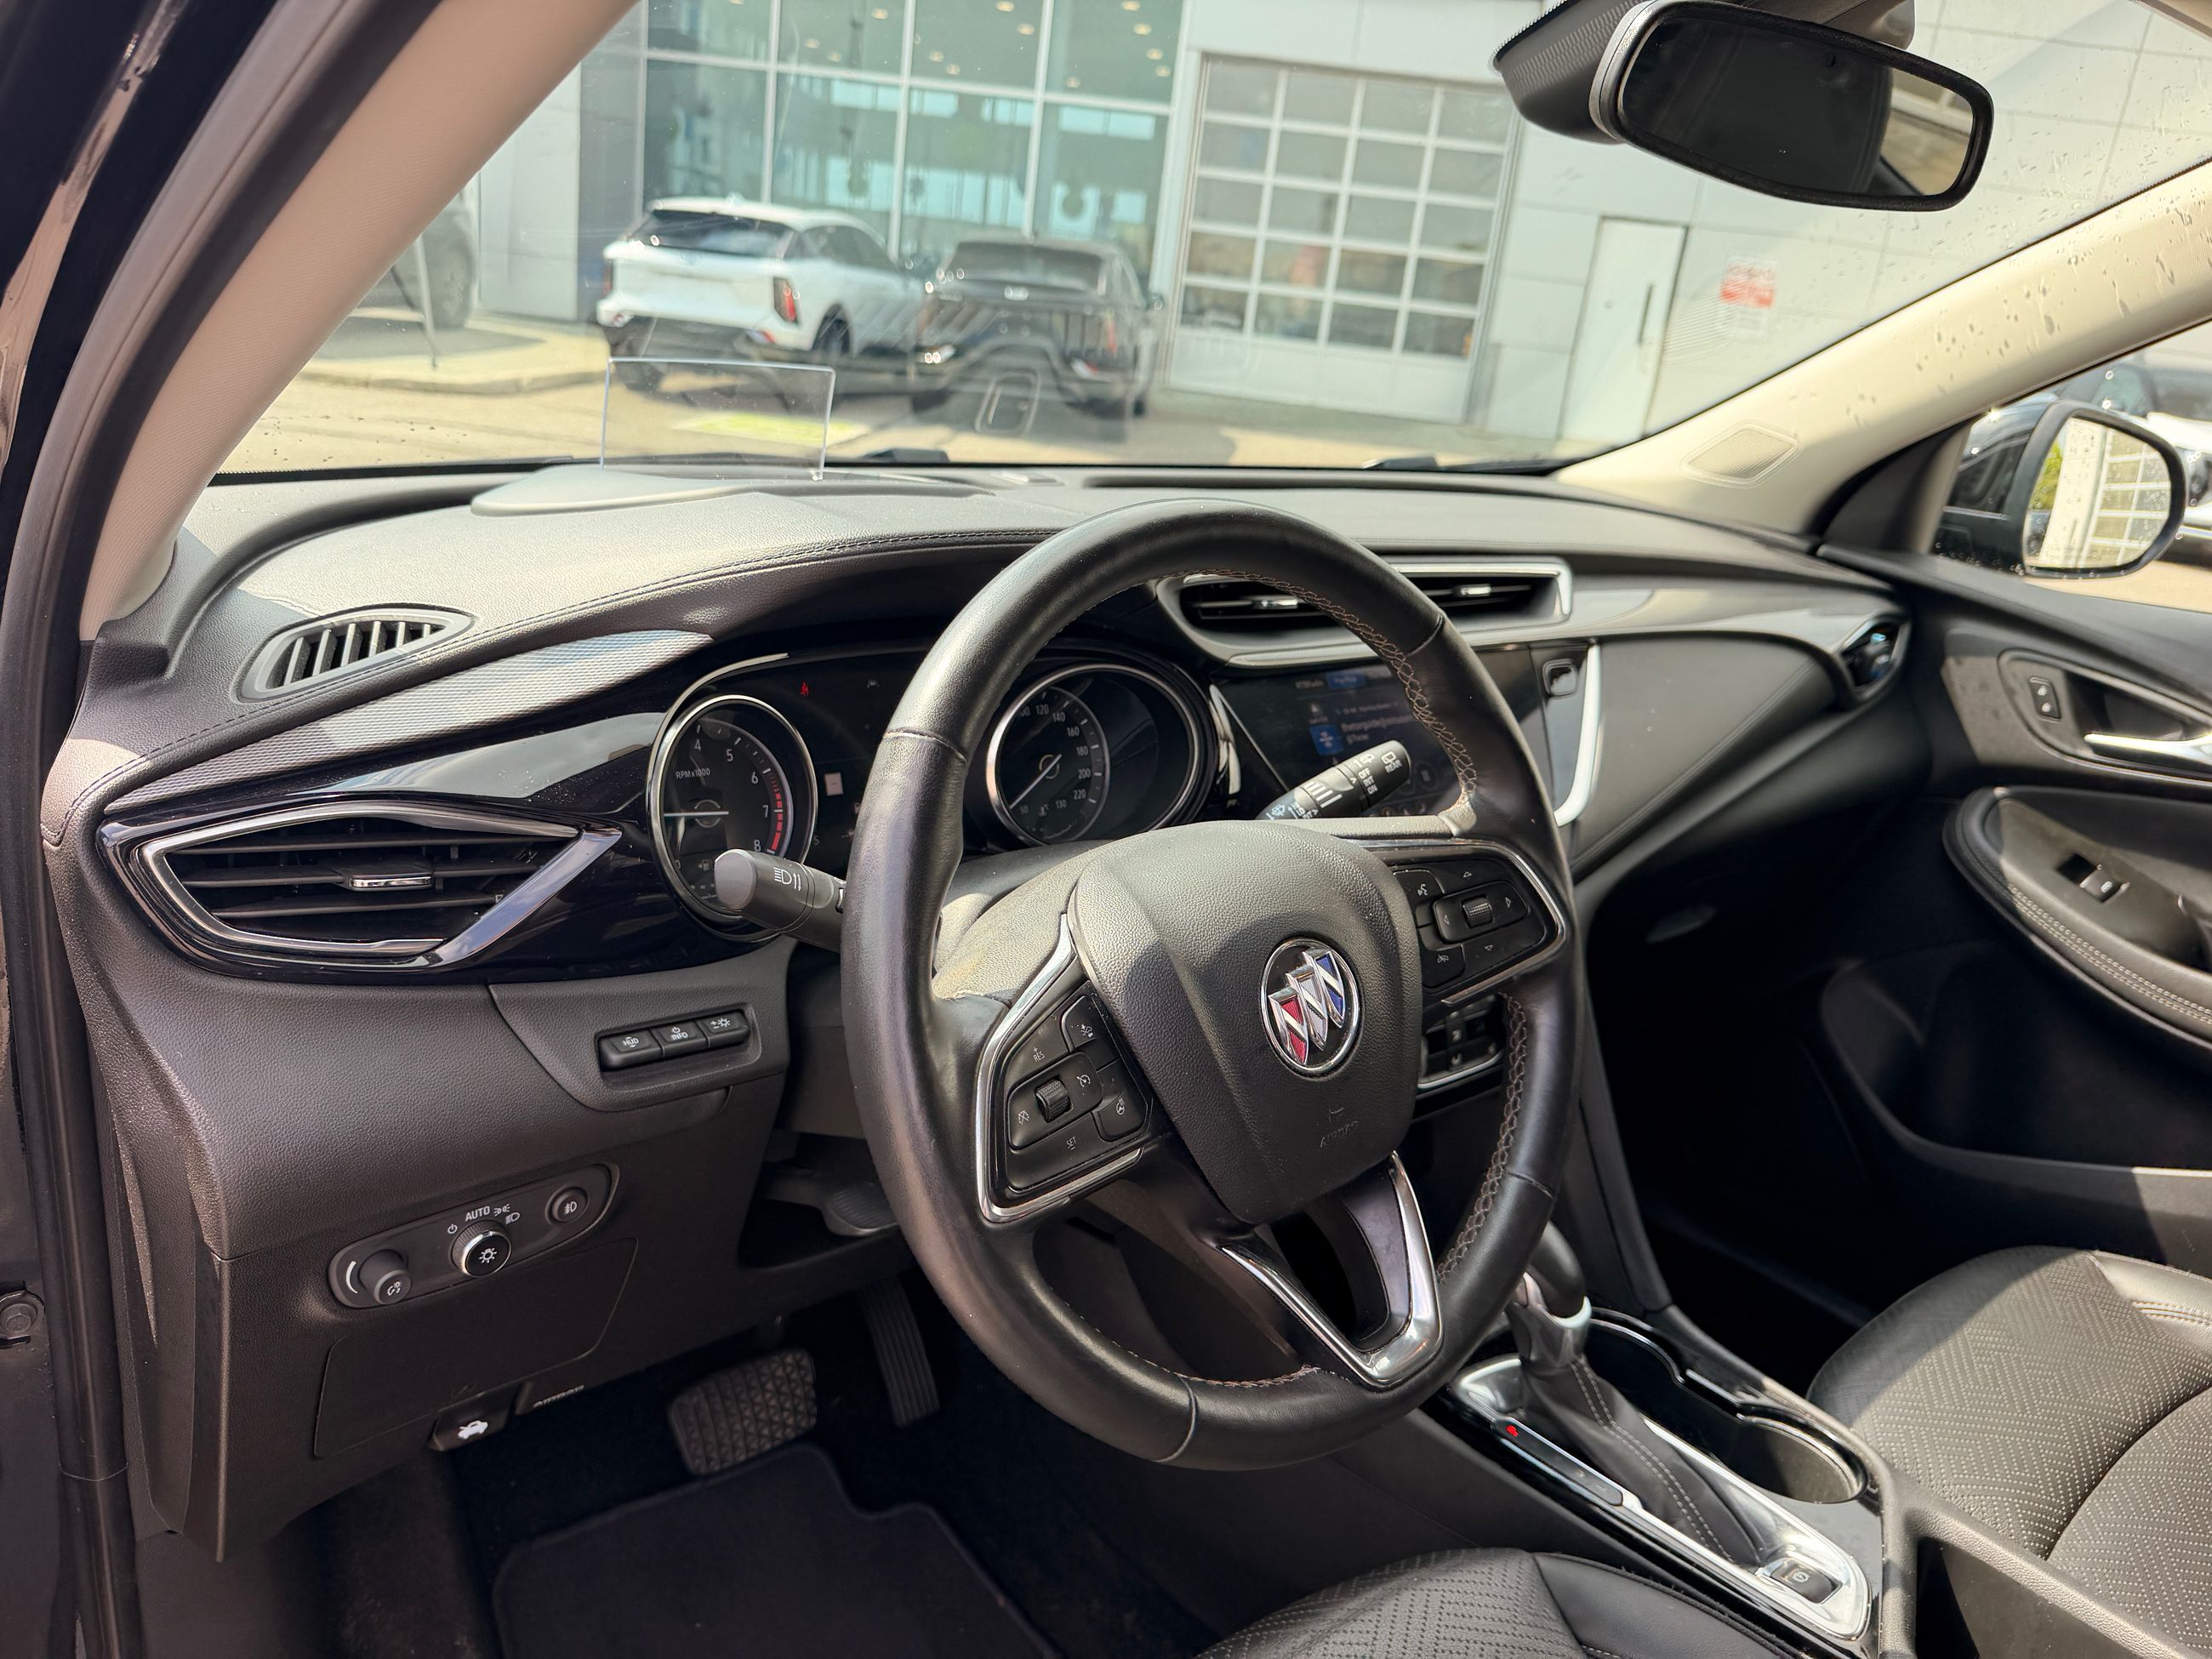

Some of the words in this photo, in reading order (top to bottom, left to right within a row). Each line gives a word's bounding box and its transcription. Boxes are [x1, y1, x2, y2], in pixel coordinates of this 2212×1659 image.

[1052, 711, 1066, 722] 140
[1067, 726, 1080, 738] 160
[694, 738, 702, 752] 4
[1076, 745, 1088, 757] 180
[726, 748, 733, 762] 5
[751, 771, 759, 784] 6
[1078, 768, 1091, 779] 200
[1073, 789, 1086, 800] 220
[762, 804, 769, 818] 7
[754, 838, 761, 852] 8
[670, 1031, 688, 1040] INFO
[622, 1037, 640, 1047] HUD
[1033, 1051, 1045, 1062] RES
[1066, 1136, 1077, 1149] SET
[465, 1206, 491, 1223] AUTO
